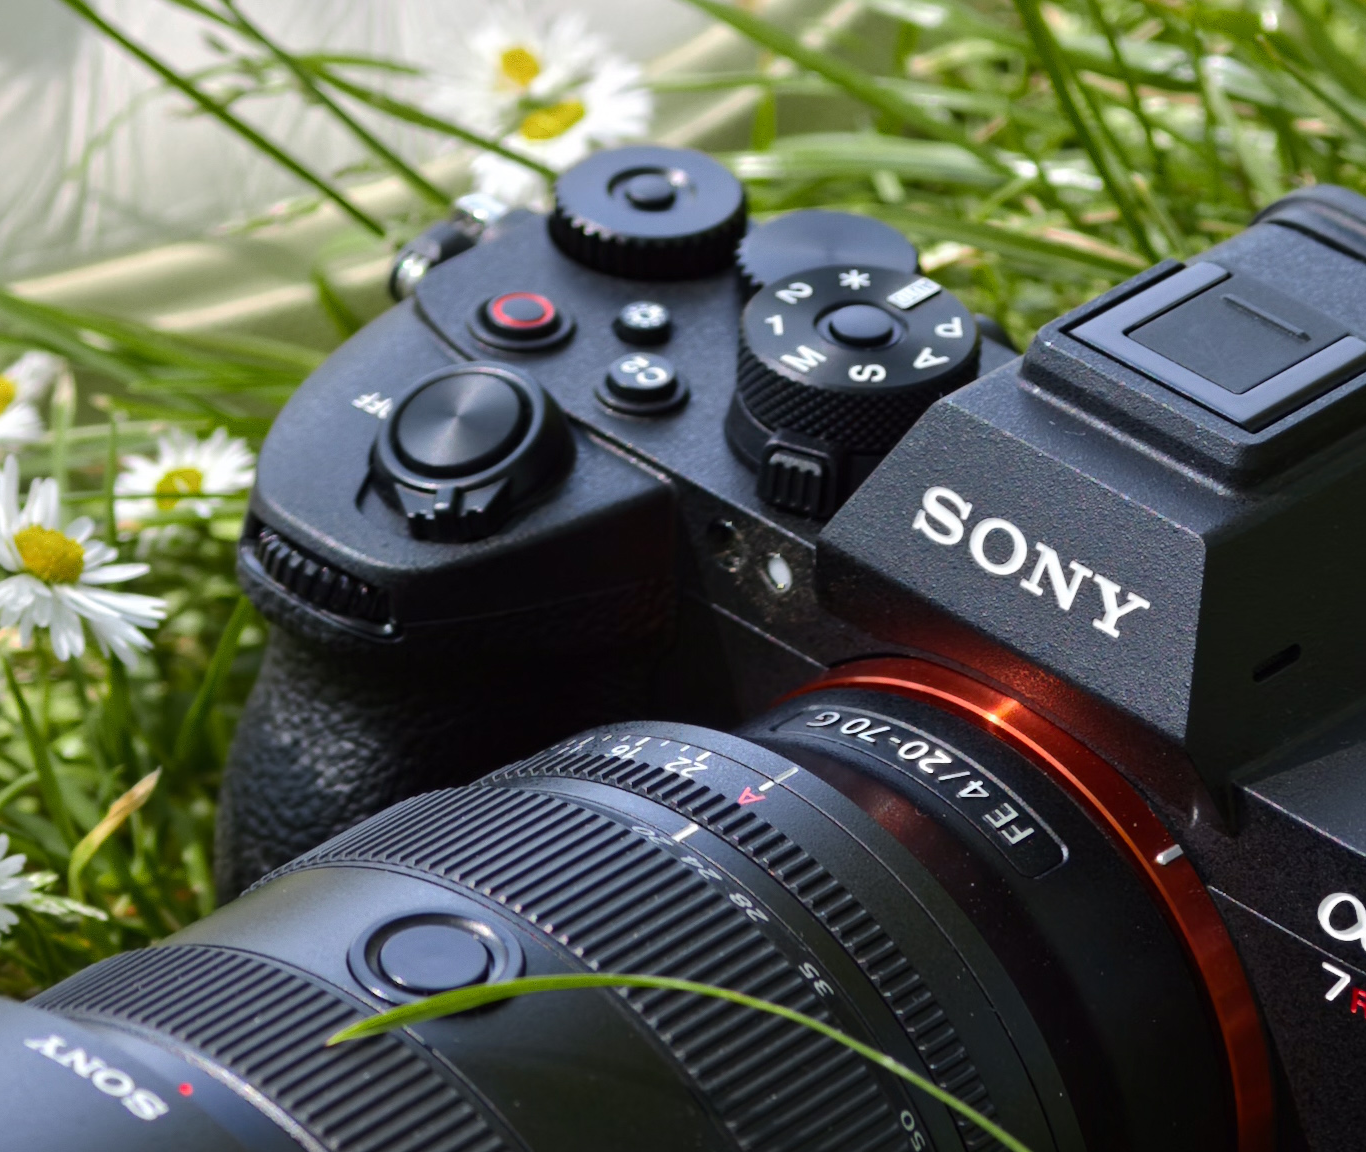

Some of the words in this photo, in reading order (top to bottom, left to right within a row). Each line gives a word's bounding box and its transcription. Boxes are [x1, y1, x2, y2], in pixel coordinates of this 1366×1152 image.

[775, 281, 813, 304] 2
[764, 314, 784, 336] 1
[934, 316, 963, 338] P
[780, 345, 827, 373] M
[912, 347, 950, 369] A
[848, 363, 887, 382] S
[912, 486, 1150, 638] SONY
[806, 711, 840, 727] G
[605, 744, 643, 760] 16
[664, 757, 709, 778] 22
[737, 786, 766, 805] A
[982, 802, 1034, 845] FE
[631, 825, 674, 846] 20
[680, 855, 723, 881] 24
[729, 892, 770, 922] 28
[798, 961, 835, 997] 35
[23, 1034, 170, 1121] SONY
[900, 1109, 926, 1152] 50
